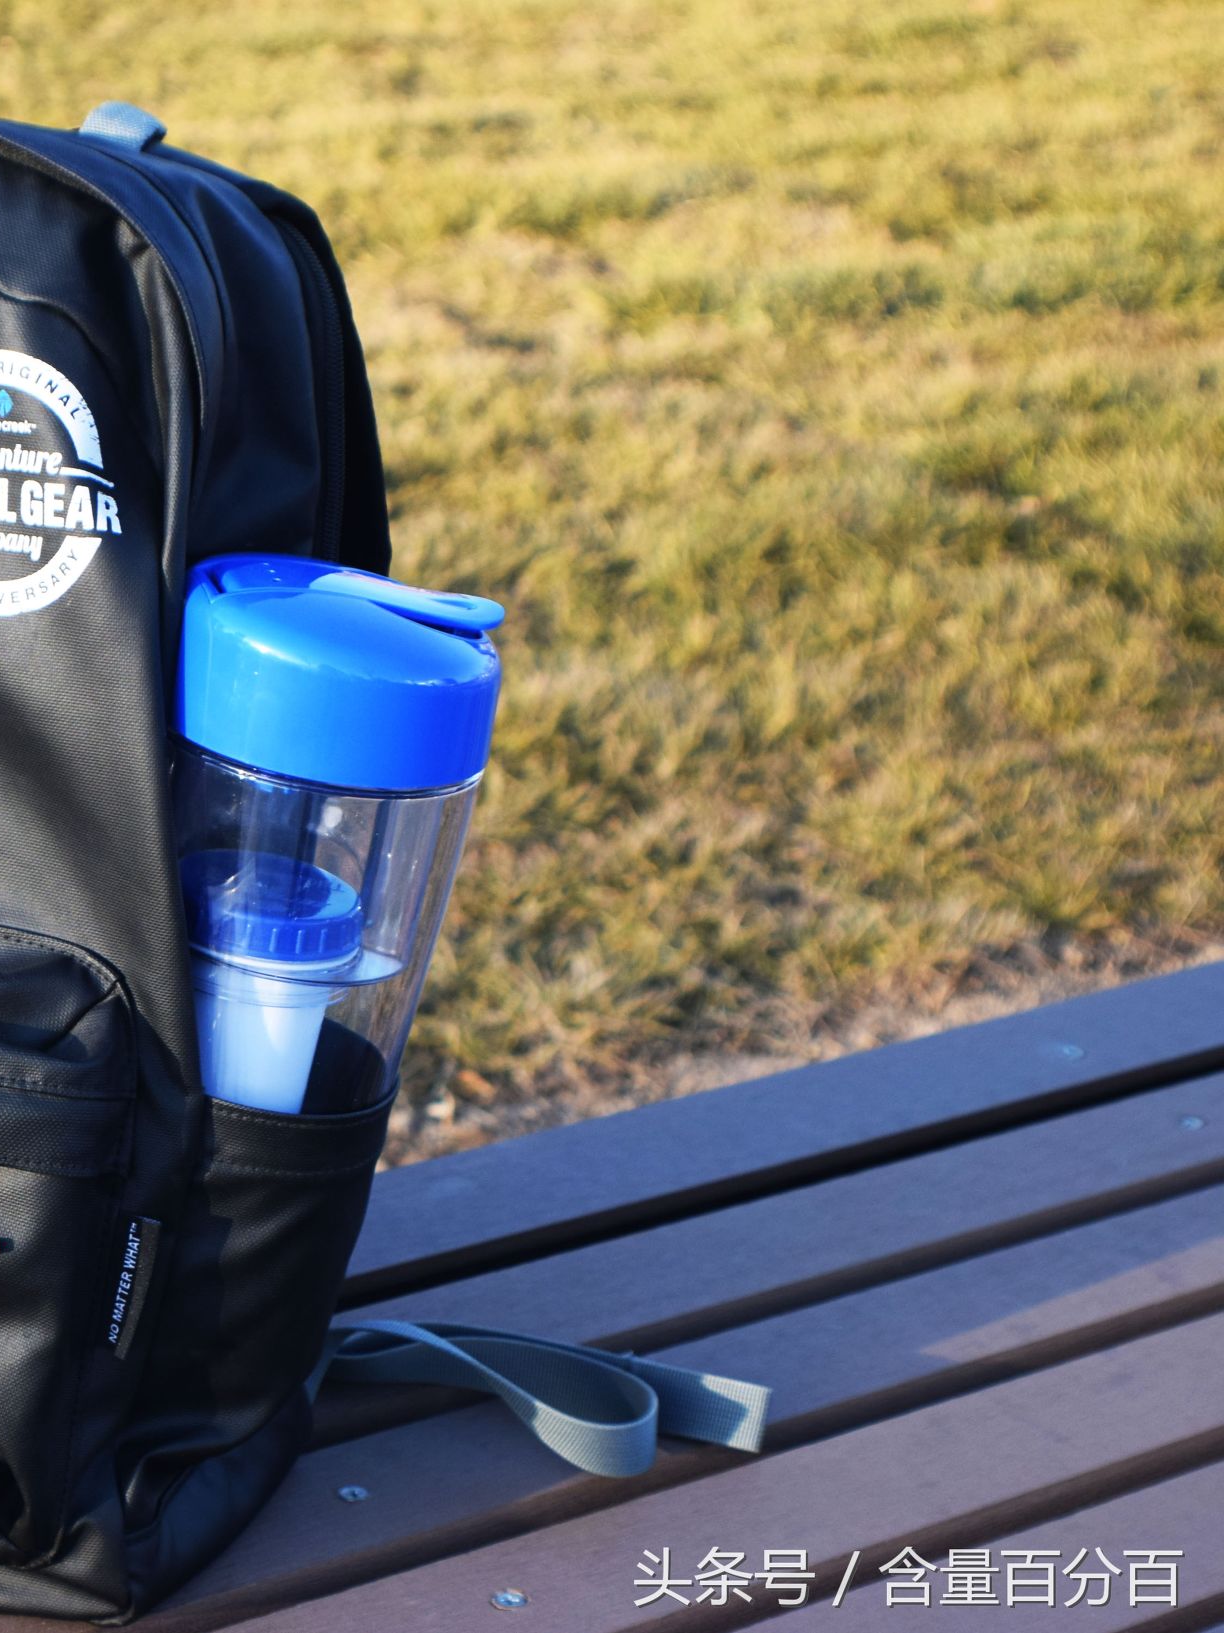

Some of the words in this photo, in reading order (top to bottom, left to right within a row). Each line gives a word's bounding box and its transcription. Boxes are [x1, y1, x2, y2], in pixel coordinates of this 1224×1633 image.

[20, 480, 122, 534] GEAR
[112, 1272, 133, 1321] MATTER
[109, 1324, 119, 1343] NO
